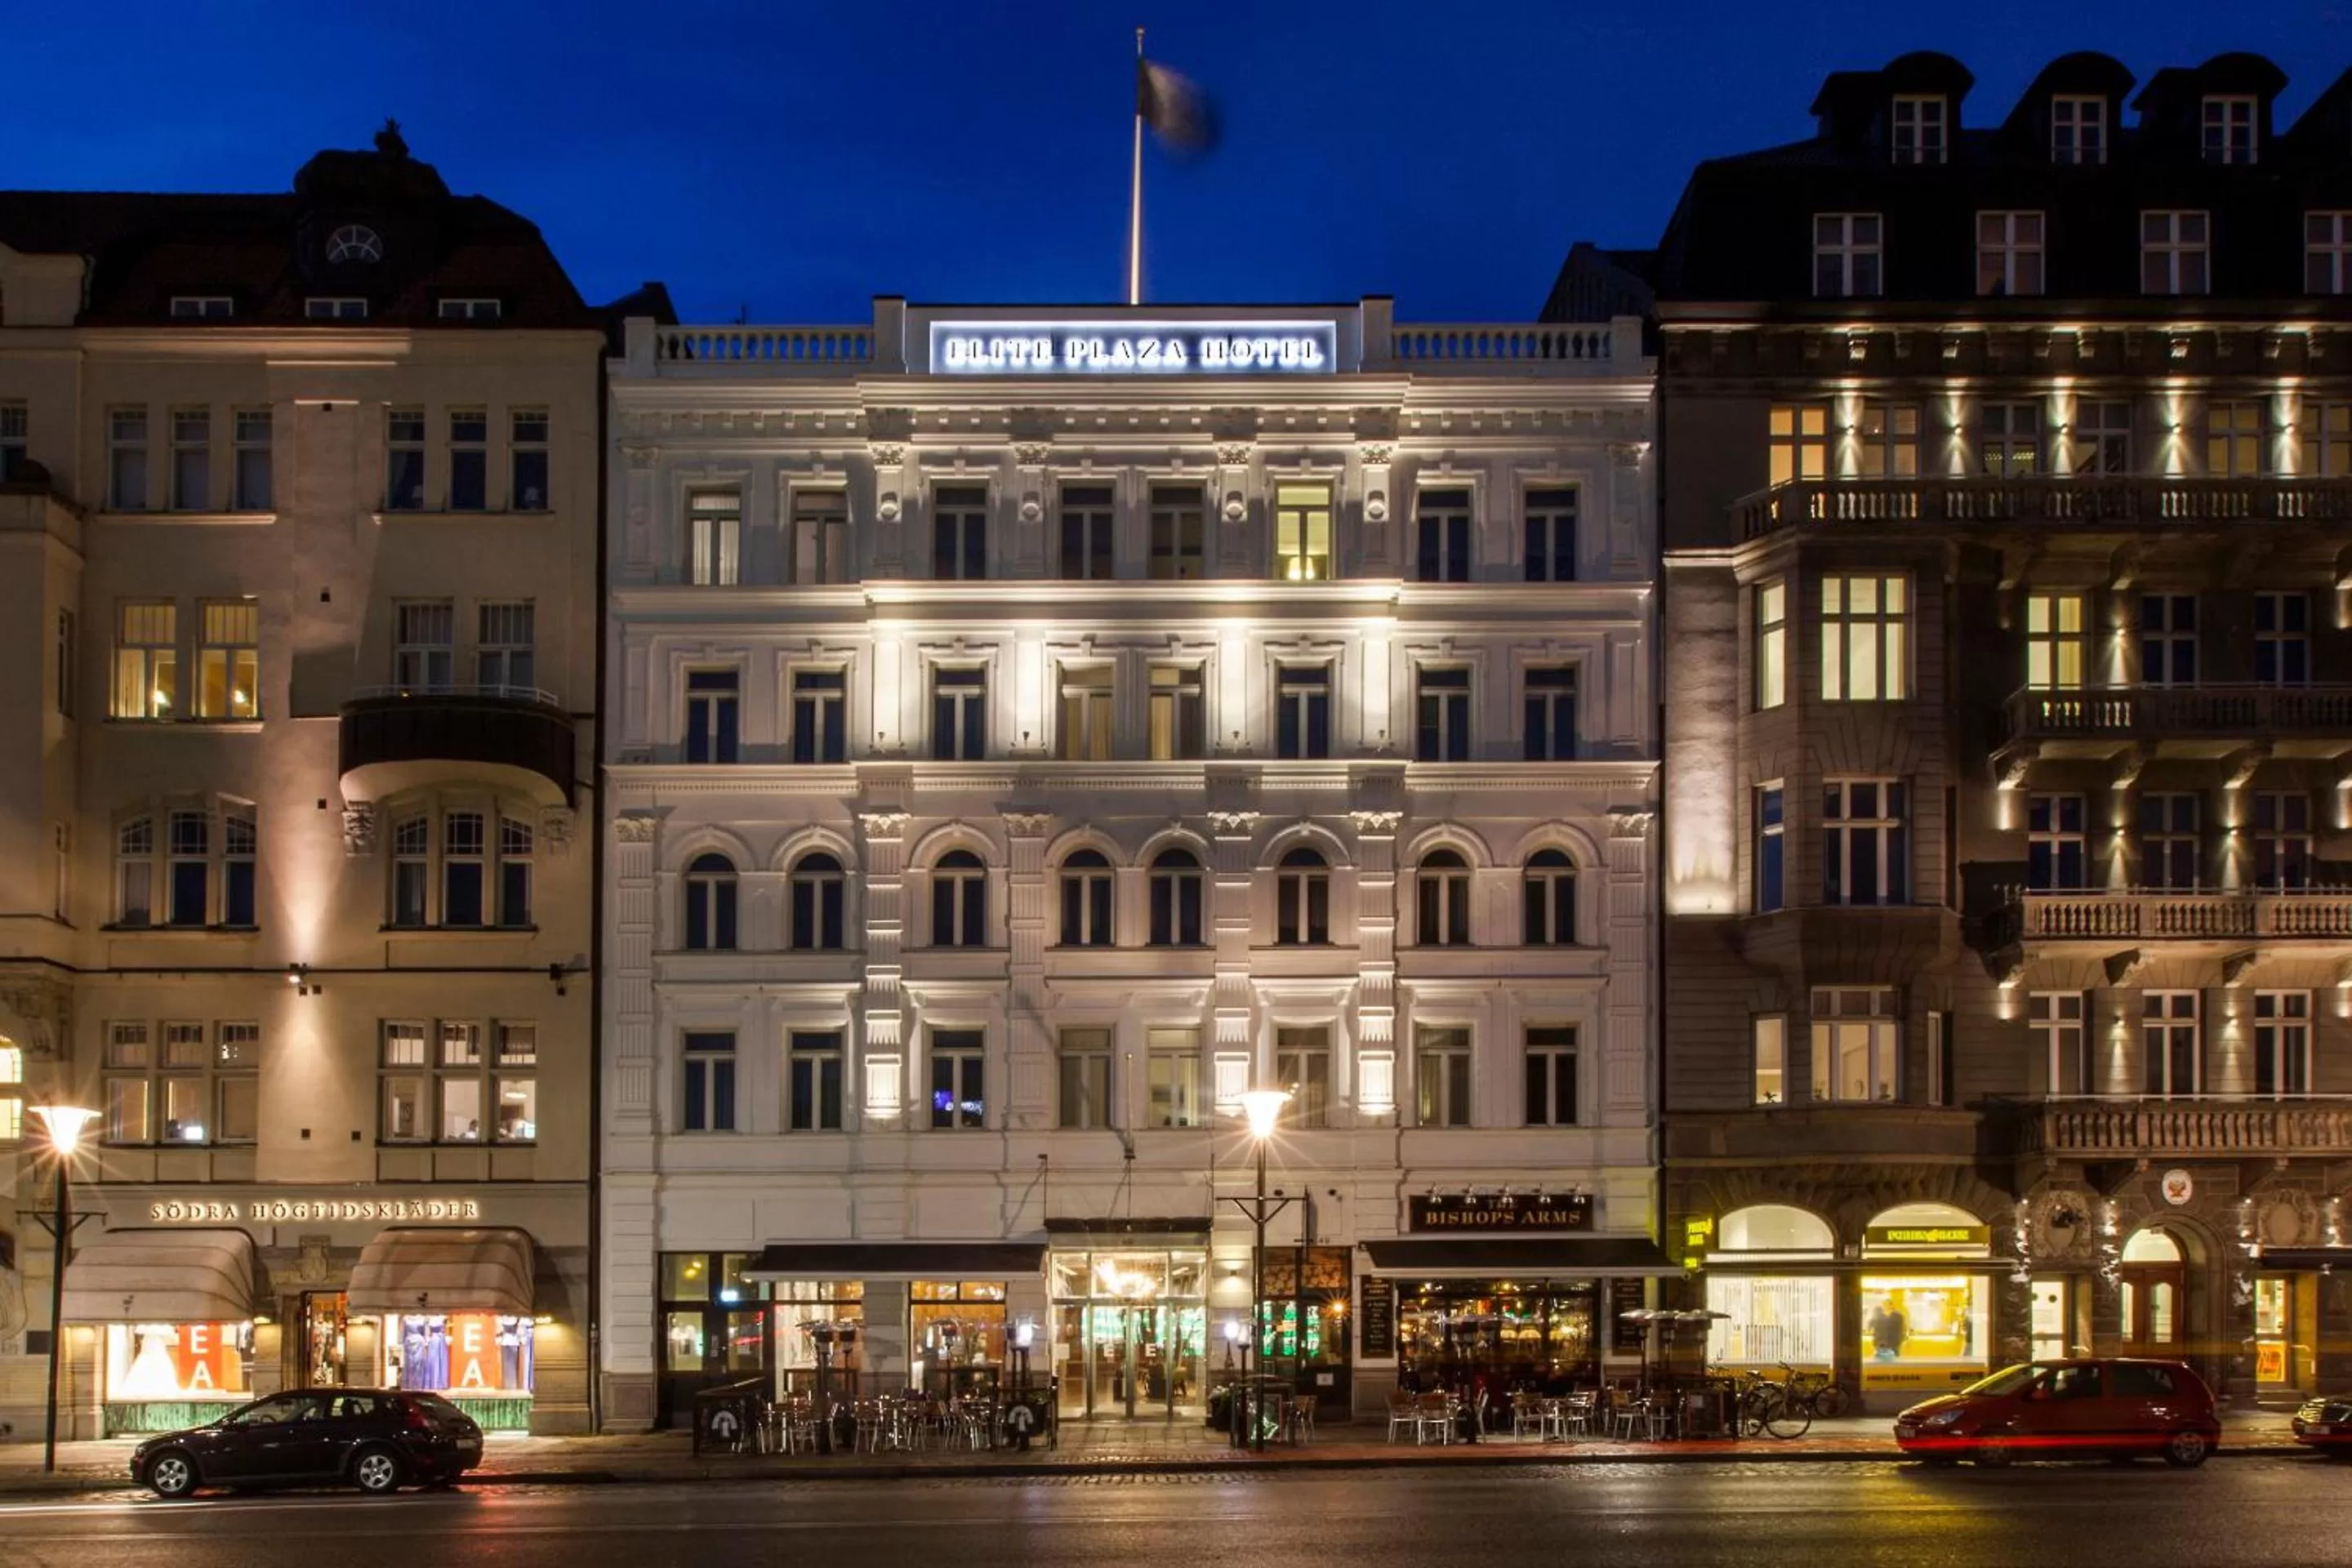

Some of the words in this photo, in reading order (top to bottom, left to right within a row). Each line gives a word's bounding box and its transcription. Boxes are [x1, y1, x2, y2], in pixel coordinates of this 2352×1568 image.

[947, 339, 1052, 364] ELITE
[1068, 339, 1185, 364] PLAZA
[1203, 339, 1323, 364] HOTEL
[150, 1202, 236, 1219] SÖDRA
[252, 1200, 475, 1218] HÖGTIDSKLÄDER
[1425, 1211, 1515, 1224] BISHOPS
[1521, 1210, 1580, 1223] ARMS
[1146, 1343, 1156, 1357] E
